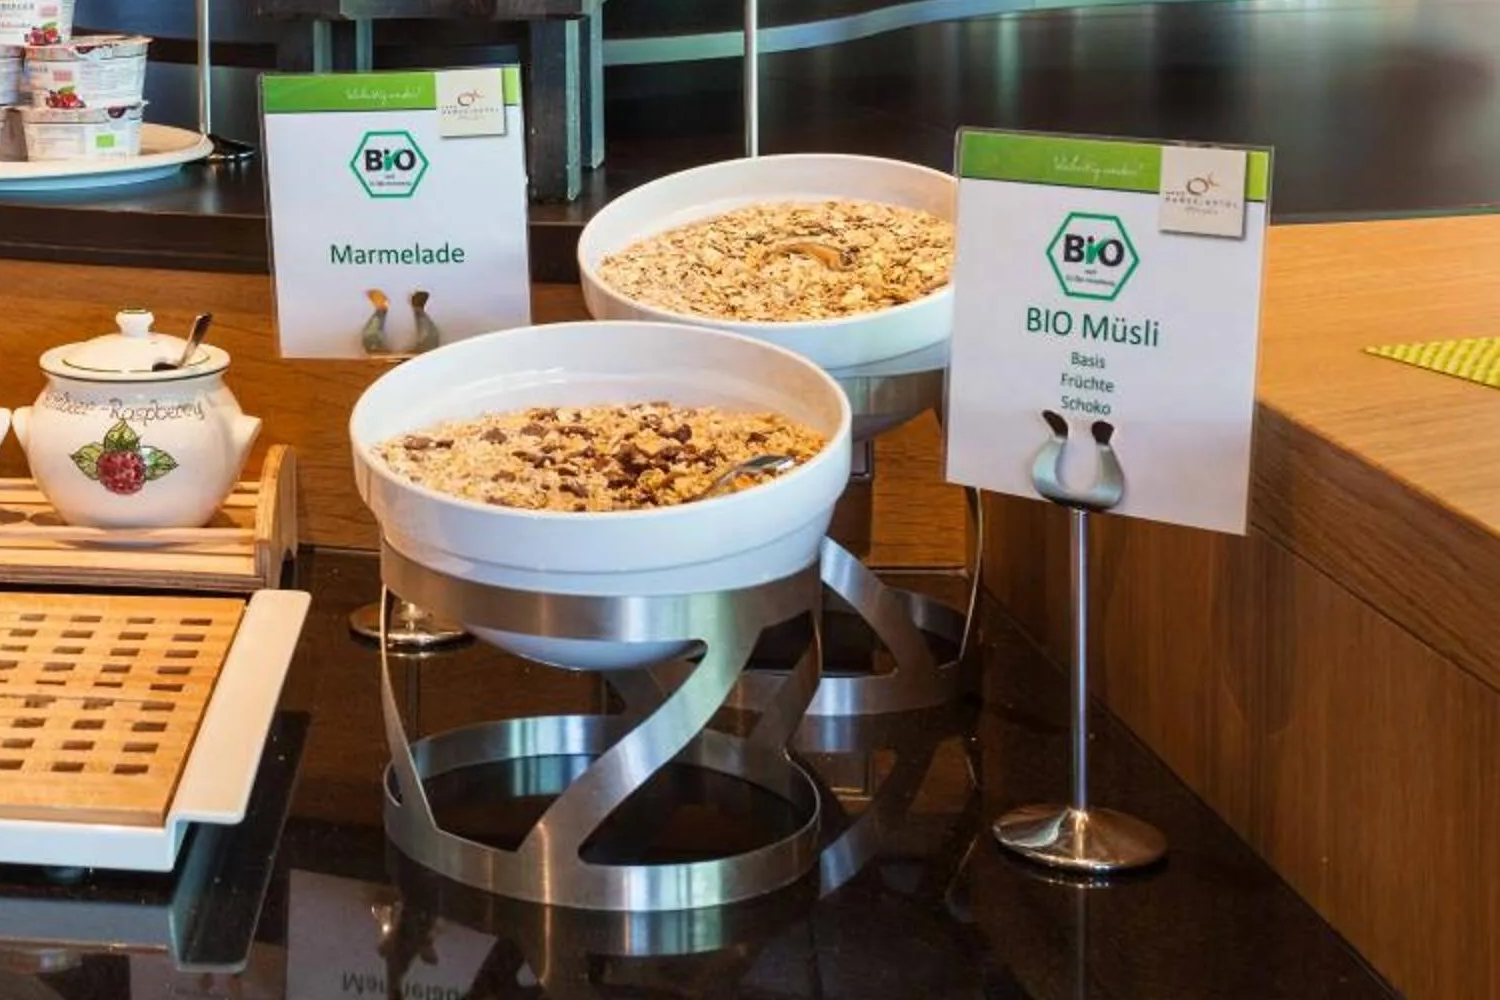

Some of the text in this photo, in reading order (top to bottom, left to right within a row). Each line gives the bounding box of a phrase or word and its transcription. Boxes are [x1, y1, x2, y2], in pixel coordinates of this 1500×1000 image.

[330, 242, 465, 265] Marmelade
[1026, 307, 1160, 347] BIO Müsli
[1071, 352, 1106, 369] Basis
[1060, 373, 1114, 393] Früchte
[1060, 395, 1111, 416] Schoko
